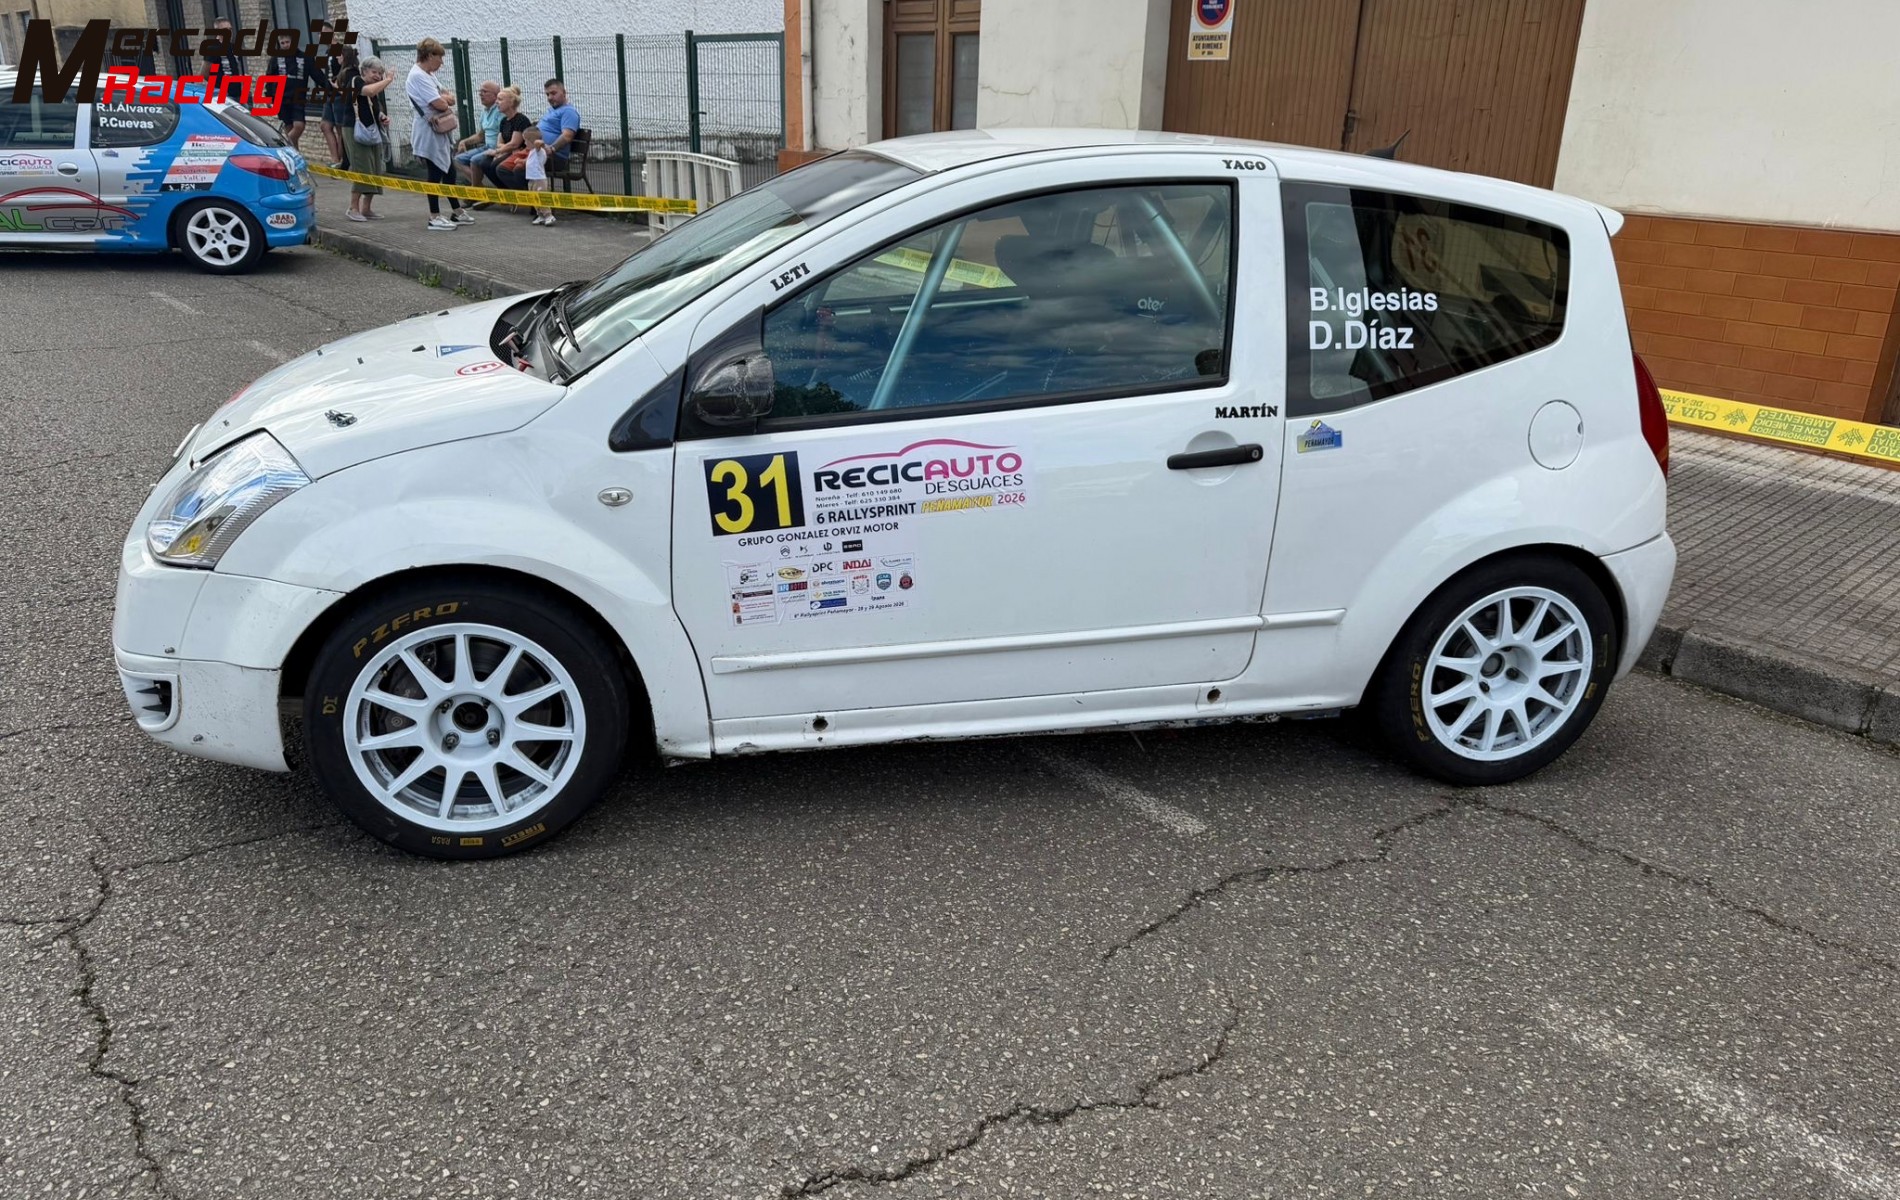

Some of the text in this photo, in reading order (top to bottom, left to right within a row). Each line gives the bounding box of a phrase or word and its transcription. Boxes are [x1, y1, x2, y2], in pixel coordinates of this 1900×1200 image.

[99, 117, 155, 129] P.Cuevas
[0, 158, 53, 169] CICAUTO
[1222, 159, 1267, 171] YAGO
[770, 262, 811, 292] LETI
[1309, 287, 1438, 317] B.Iglesias
[1309, 319, 1414, 350] D.Díaz
[1662, 394, 1689, 404] ASTU
[1215, 403, 1278, 419] MARTÍN
[1681, 406, 1716, 422] CAJA
[1771, 411, 1833, 428] AMBIENTE
[1751, 425, 1825, 445] COMPROMETIDOS
[1754, 417, 1829, 437] CON EL MEDIO
[813, 452, 1023, 492] RECICAUTO
[925, 474, 1024, 495] DESGUACES
[710, 454, 793, 534] 31
[815, 494, 841, 502] Noreña
[816, 501, 839, 509] Mieres
[816, 512, 825, 524] 6
[828, 502, 917, 523] RALLYSPRINT
[997, 491, 1026, 505] 2026
[738, 522, 899, 547] GRUPO GONZALEZ ORVIZ MOTOR
[812, 561, 834, 573] DPC
